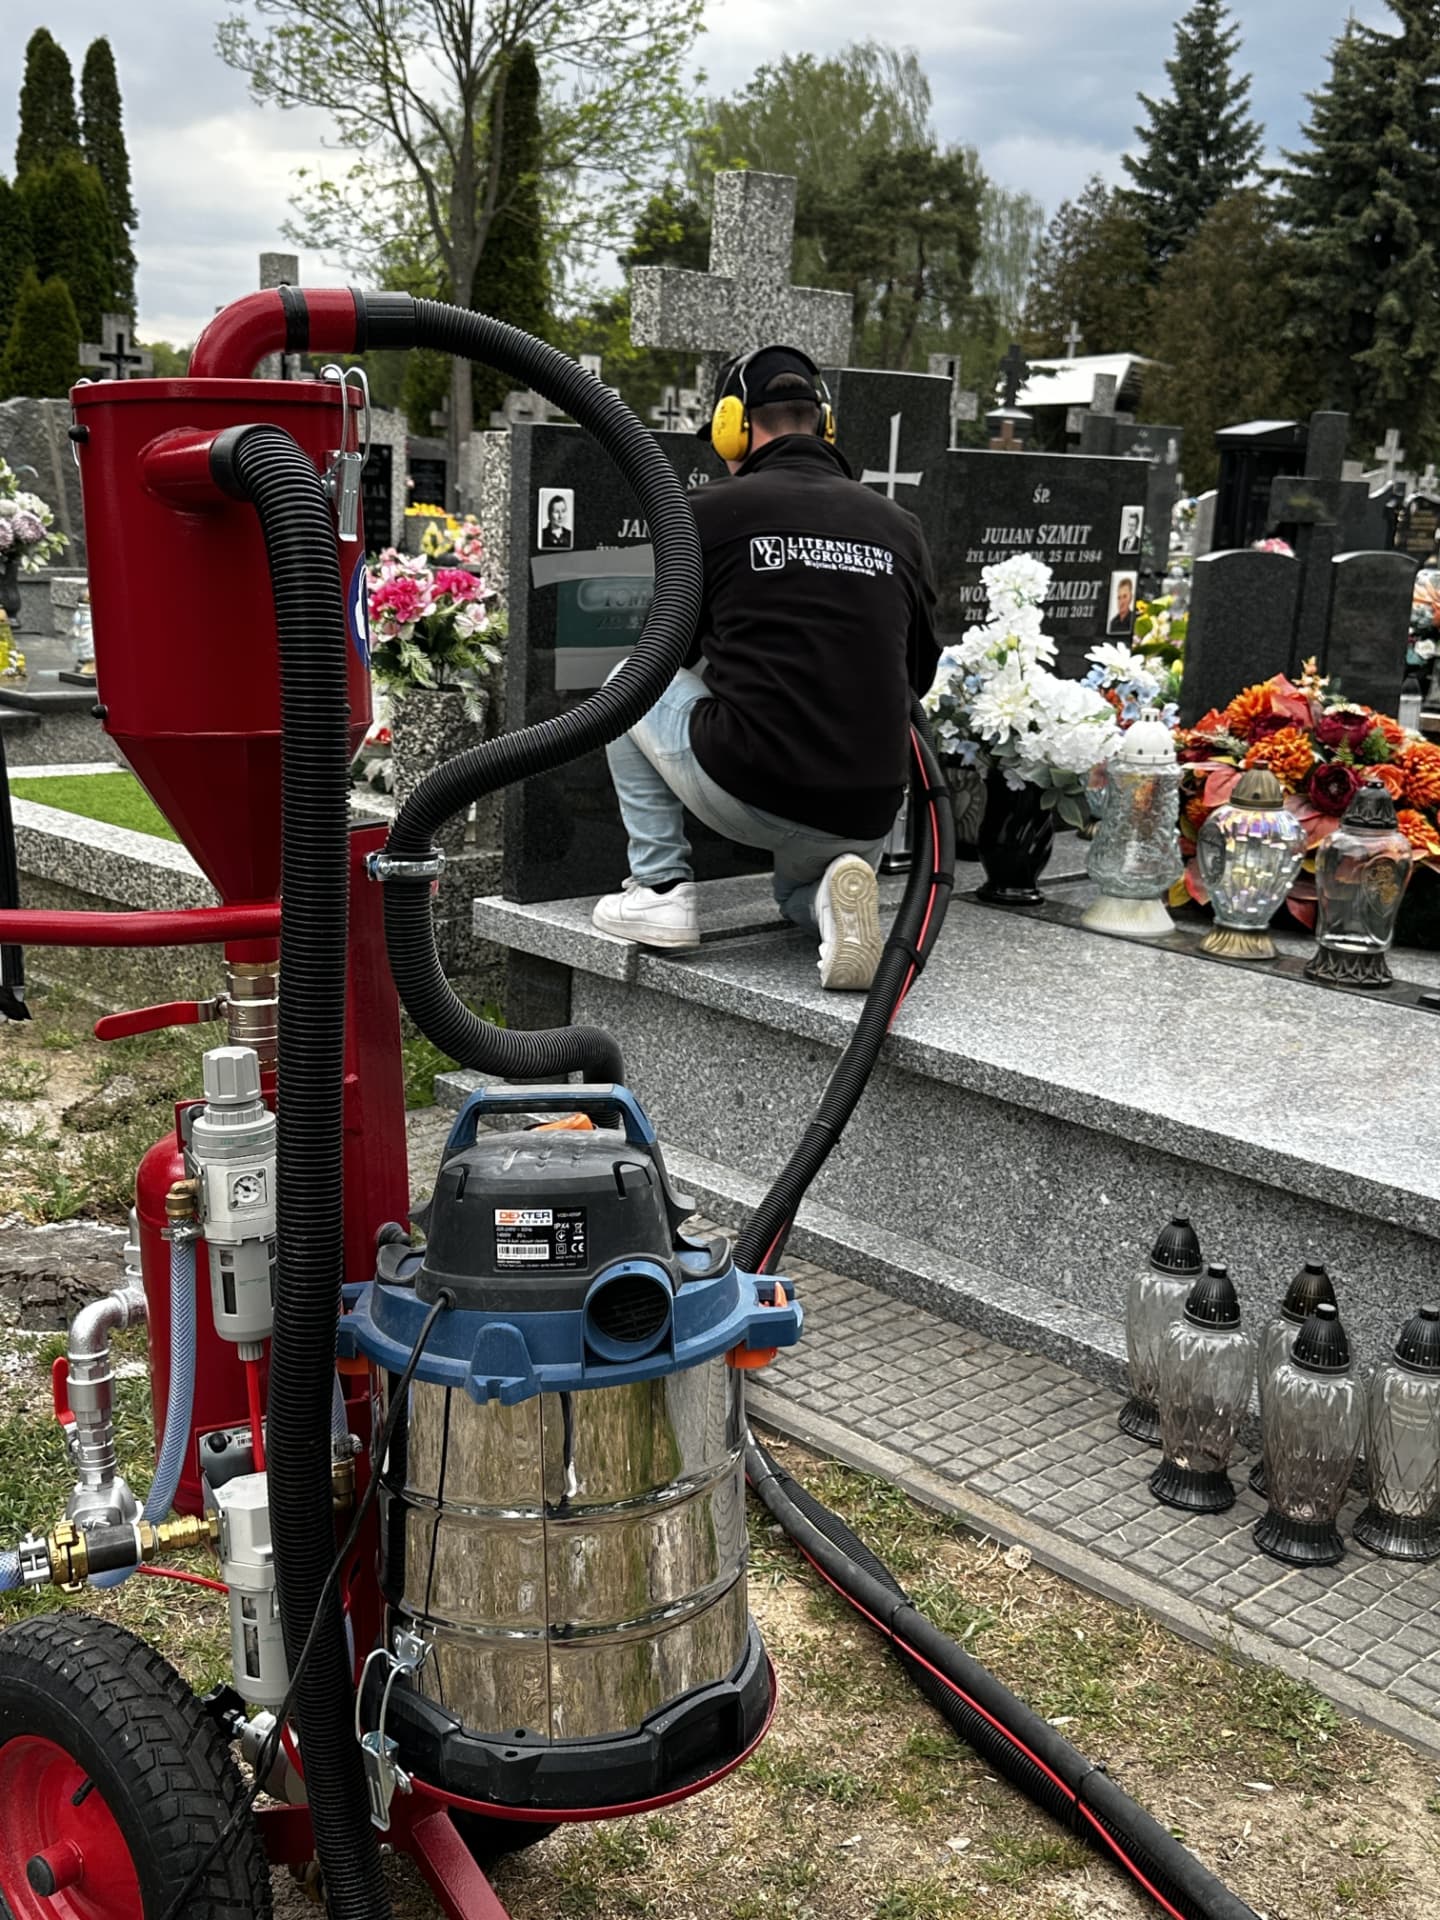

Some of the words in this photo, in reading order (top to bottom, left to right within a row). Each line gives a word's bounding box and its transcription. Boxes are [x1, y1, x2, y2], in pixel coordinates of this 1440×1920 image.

[981, 527, 1034, 545] JULIAN
[1036, 524, 1093, 545] SZMIT
[787, 537, 893, 563] LITERNICTWO
[1077, 549, 1103, 563] 1984
[787, 549, 893, 575] NAGROBKOWE
[1046, 581, 1103, 601] ZMIDT
[499, 1211, 551, 1219] DEXTER
